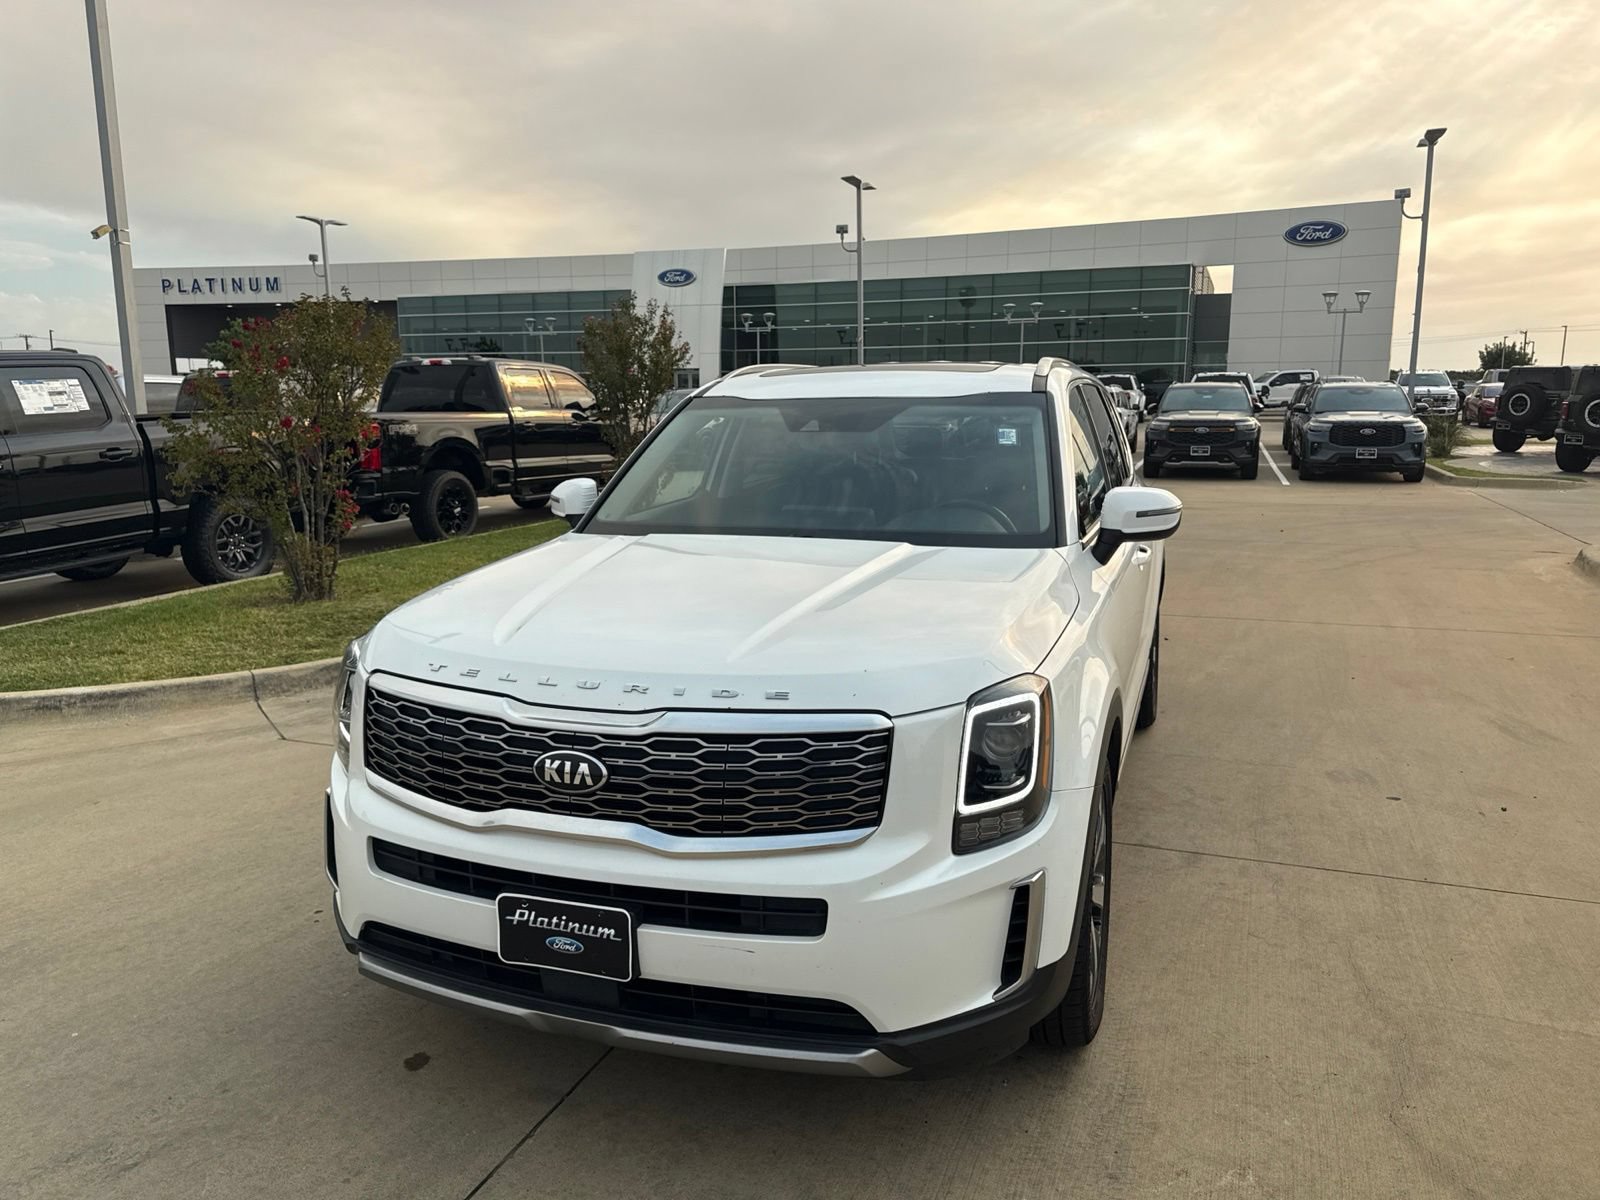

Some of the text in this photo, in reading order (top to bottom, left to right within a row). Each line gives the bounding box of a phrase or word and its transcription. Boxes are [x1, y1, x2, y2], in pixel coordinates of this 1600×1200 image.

[1296, 225, 1333, 240] Ford
[664, 271, 687, 282] Ford
[161, 277, 280, 293] PLATINUM
[429, 663, 791, 700] TELLURIDE
[544, 758, 593, 786] KIA
[505, 908, 622, 941] Platinum
[553, 939, 577, 952] Ford
